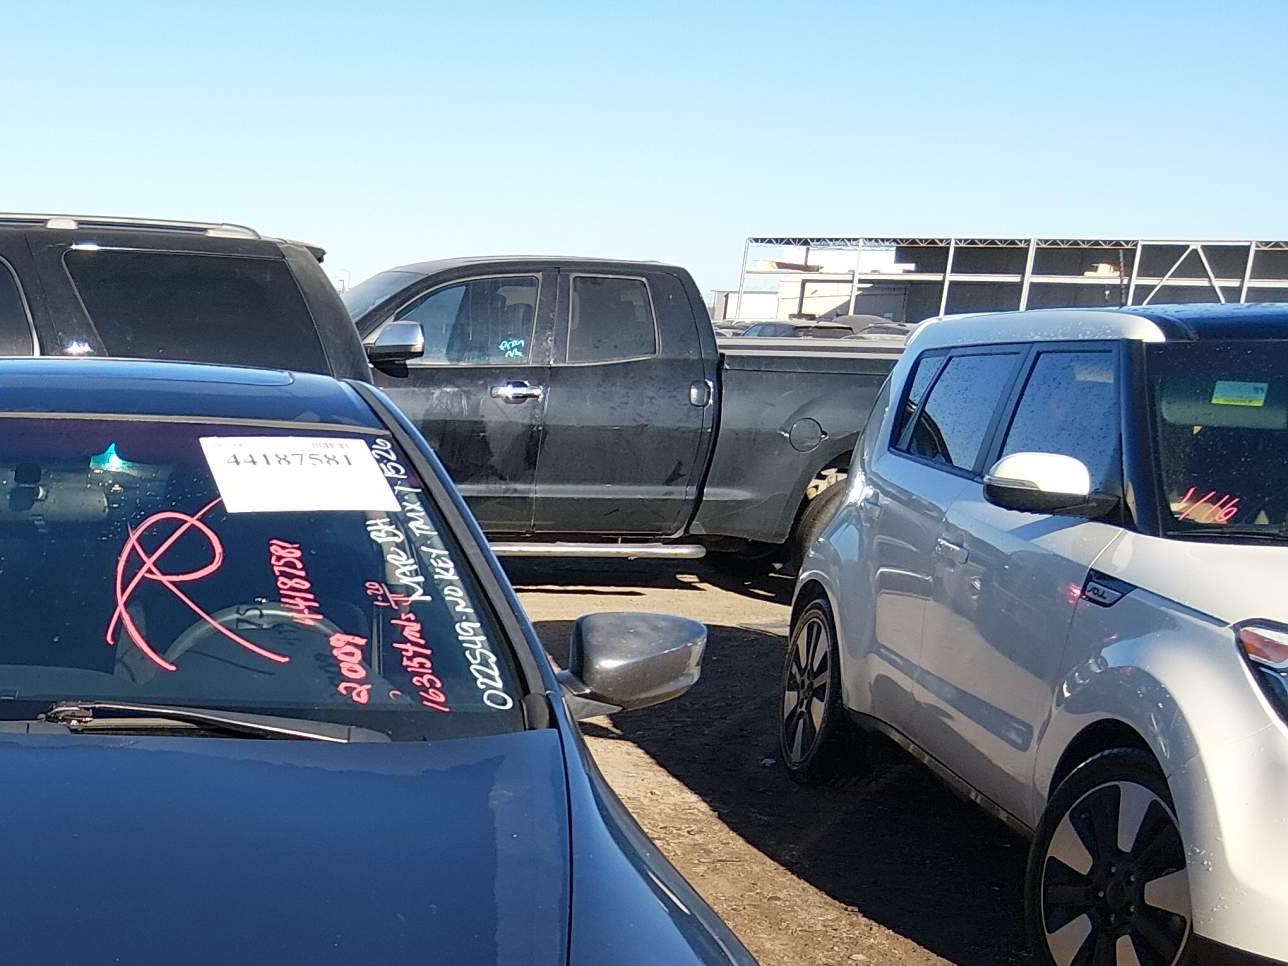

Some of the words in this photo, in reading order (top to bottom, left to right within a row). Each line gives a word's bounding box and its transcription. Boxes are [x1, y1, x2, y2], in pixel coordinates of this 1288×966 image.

[227, 452, 354, 467] 44187581
[268, 538, 325, 626] 44187581
[328, 632, 373, 705] 2009
